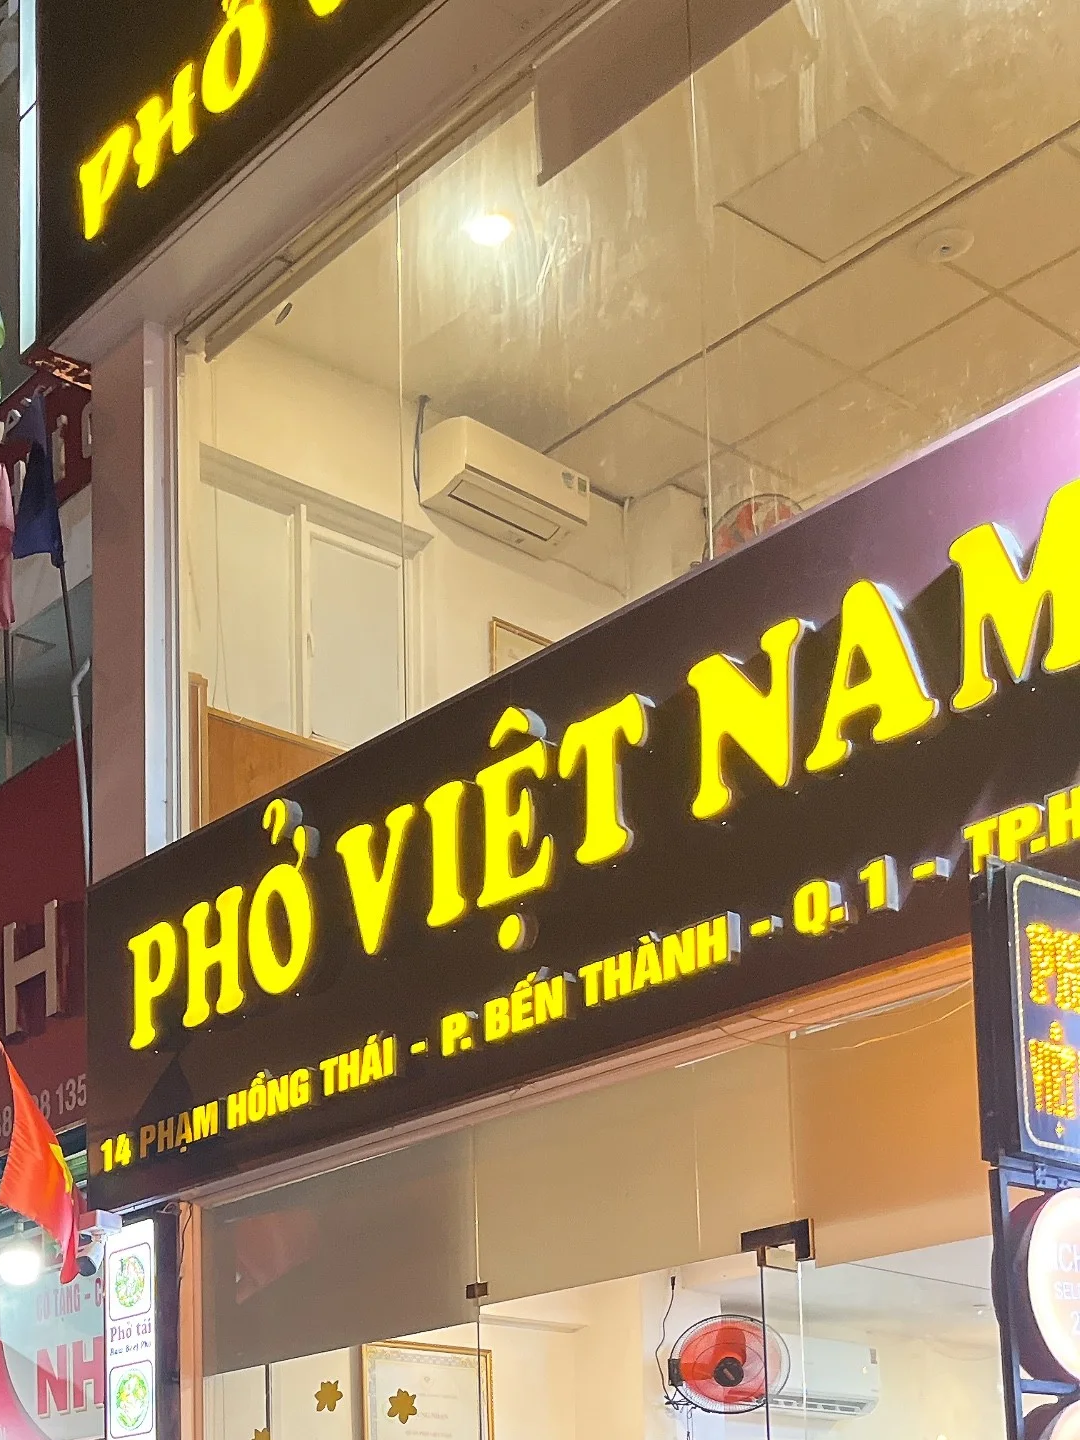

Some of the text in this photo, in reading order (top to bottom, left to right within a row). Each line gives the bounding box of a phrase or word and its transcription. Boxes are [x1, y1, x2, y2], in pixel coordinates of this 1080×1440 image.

[128, 479, 1080, 1051] PHỞ VIỆT NAM
[55, 1073, 88, 1115] 135
[100, 1133, 132, 1174] 14
[139, 1099, 220, 1155] PHẠM
[226, 1069, 313, 1131] HỒNG
[319, 1033, 397, 1097] THÁI
[441, 1011, 473, 1058] P.
[484, 968, 568, 1044] BẾN
[577, 912, 738, 1008] THÀNH
[792, 879, 848, 937] Q.
[860, 857, 898, 912] 1
[109, 1321, 133, 1343] Phở
